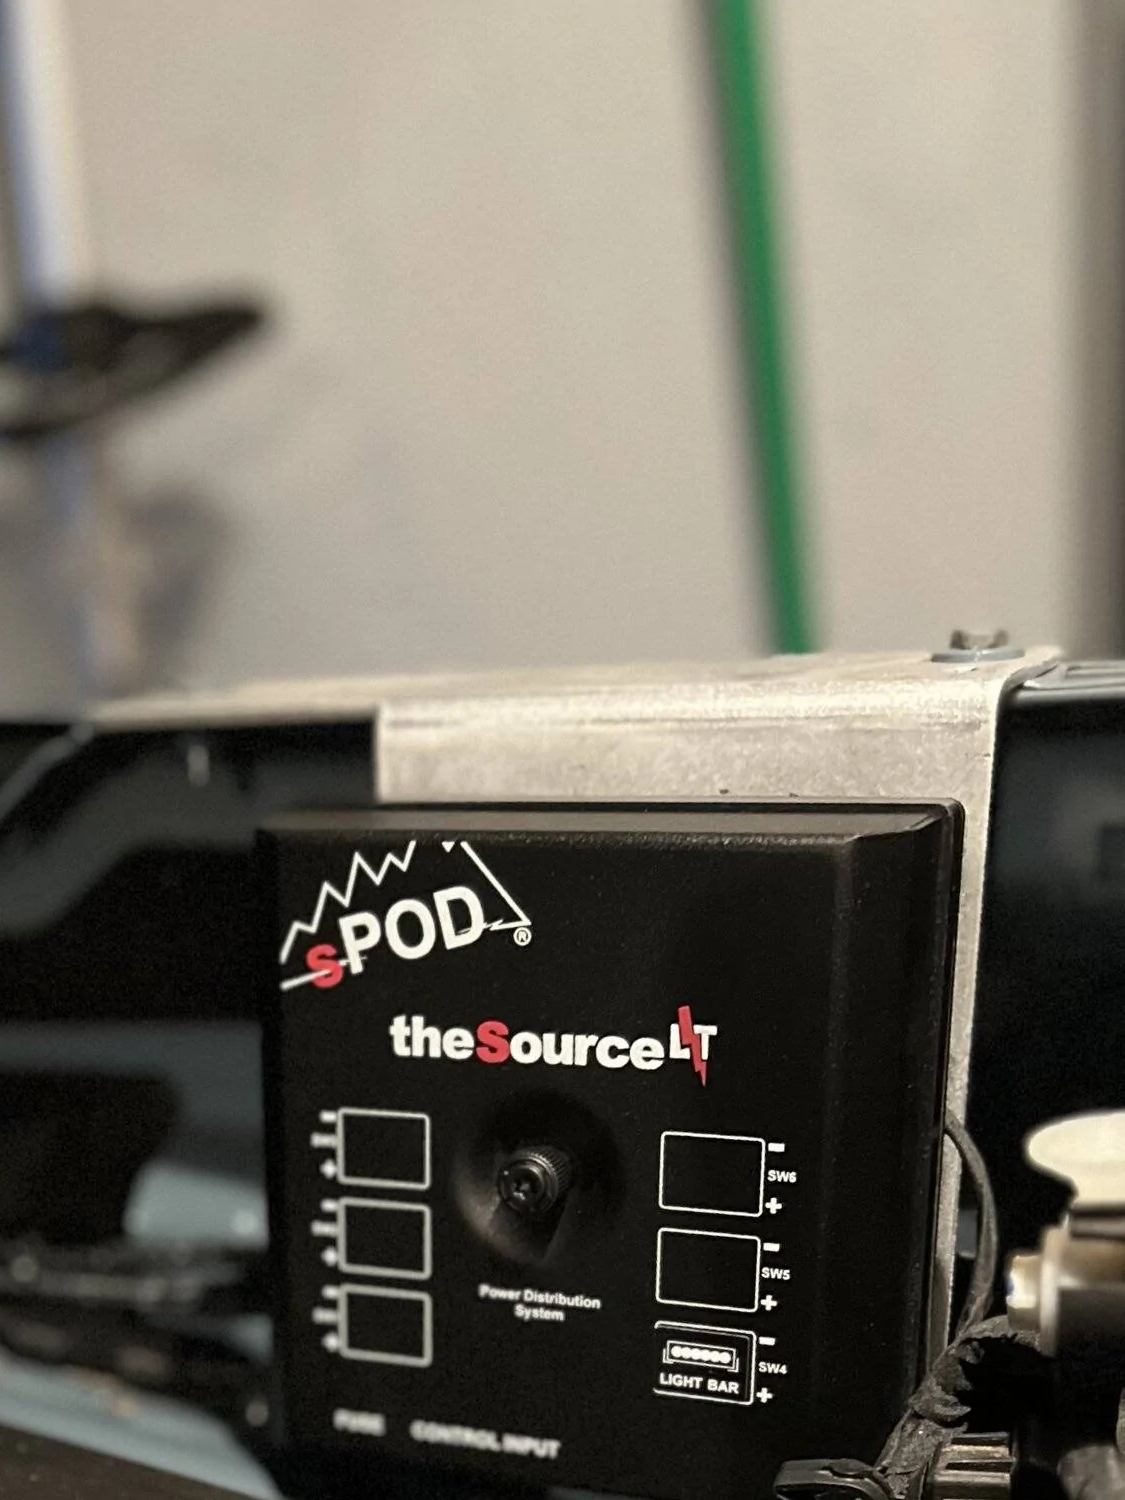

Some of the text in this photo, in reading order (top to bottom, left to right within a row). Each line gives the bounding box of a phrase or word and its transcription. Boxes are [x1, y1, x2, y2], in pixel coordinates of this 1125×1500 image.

[306, 886, 485, 989] sPOD
[767, 1169, 797, 1183] SW6
[761, 1266, 791, 1281] SW5
[478, 1283, 602, 1310] Power Distribution
[514, 1303, 565, 1321] System
[758, 1361, 788, 1375] SW4
[659, 1372, 739, 1395] LIGHT BAR
[409, 1419, 562, 1460] CONTROL INPUT
